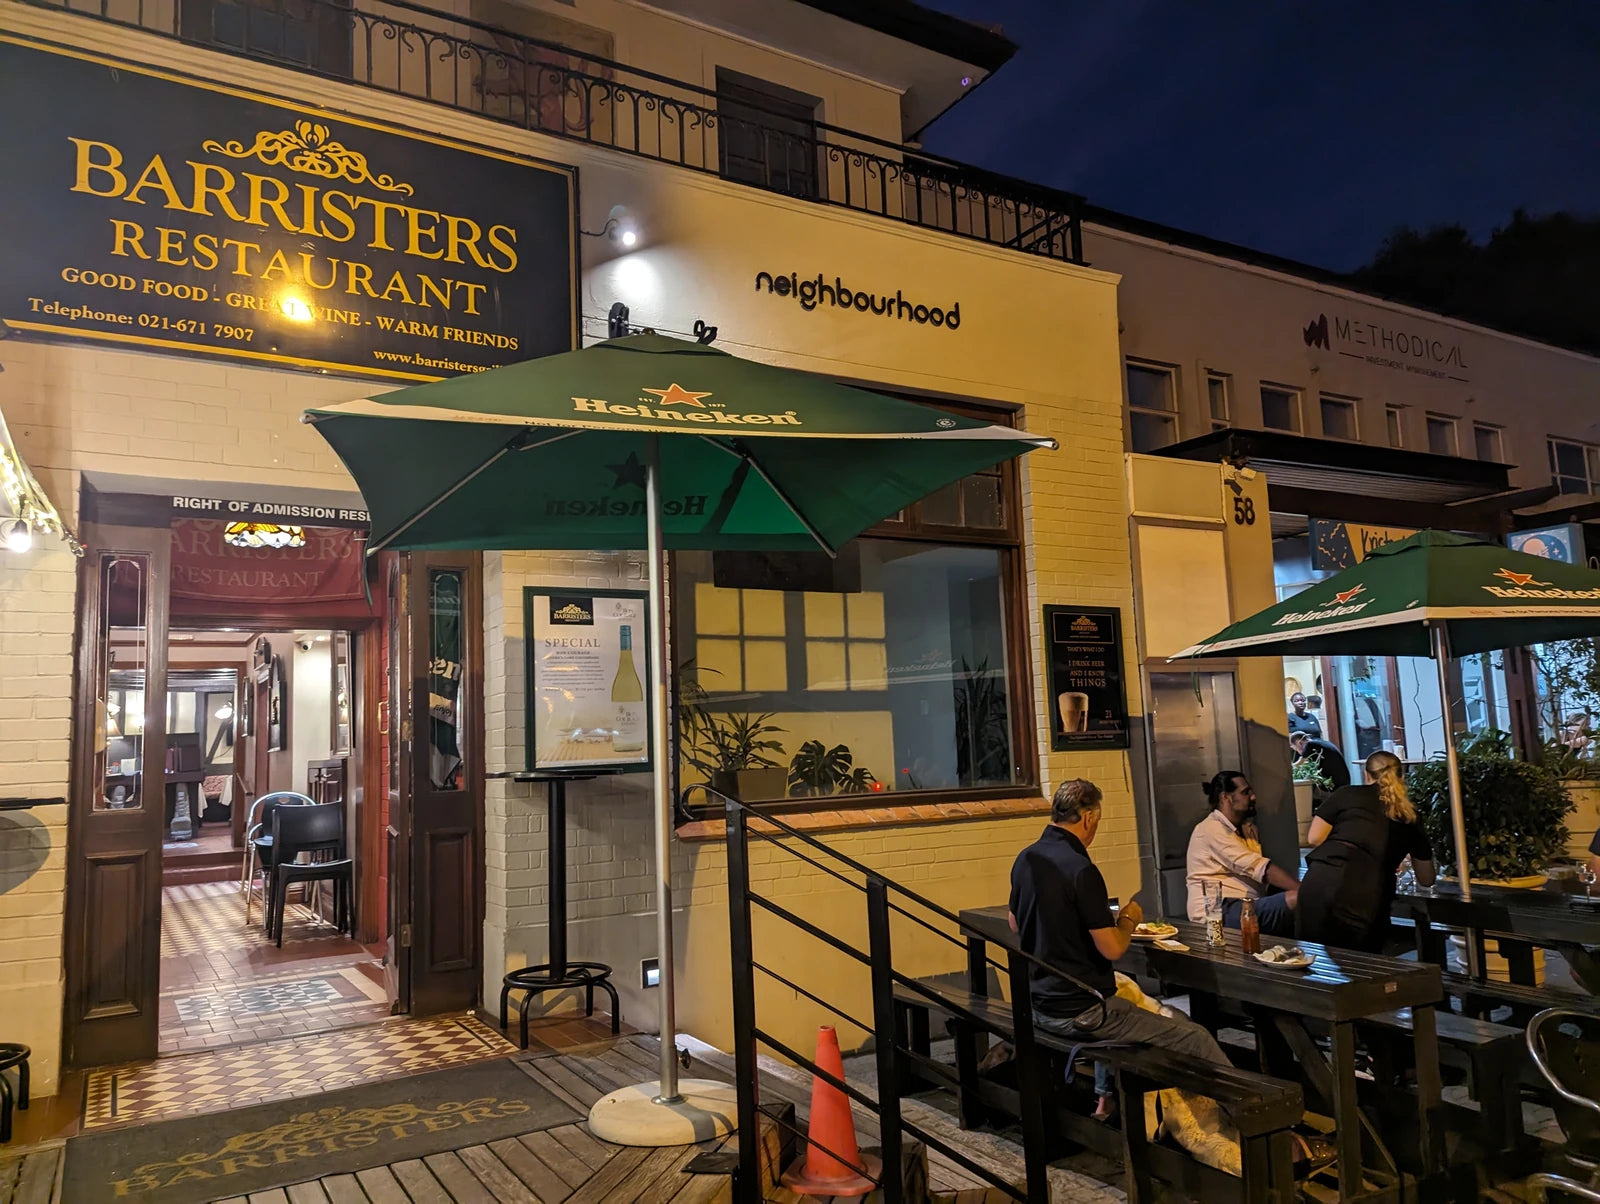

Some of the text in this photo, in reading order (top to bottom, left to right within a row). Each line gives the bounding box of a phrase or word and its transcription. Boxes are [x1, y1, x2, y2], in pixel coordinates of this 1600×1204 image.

[68, 136, 518, 273] BARRISTERS
[109, 219, 487, 316] RESTAURANT
[27, 297, 254, 342] Telephone: 021-671 7907
[61, 267, 136, 291] GOOD
[142, 279, 208, 302] FOOD
[376, 316, 439, 339] WARM
[443, 327, 519, 351] FRIENDS
[756, 272, 960, 330] neighbourhood
[1335, 316, 1469, 369] METHODICAL
[173, 497, 222, 511] RIGHT
[228, 501, 250, 513] OF
[252, 503, 336, 519] ADMISSION
[1233, 496, 1256, 525] 58
[172, 565, 324, 588] RESTAURANT
[554, 612, 592, 620] BARRISTERS
[545, 638, 601, 648] SPECIAL
[1070, 678, 1107, 687] THINGS
[108, 1099, 532, 1197] BARRISTERS
